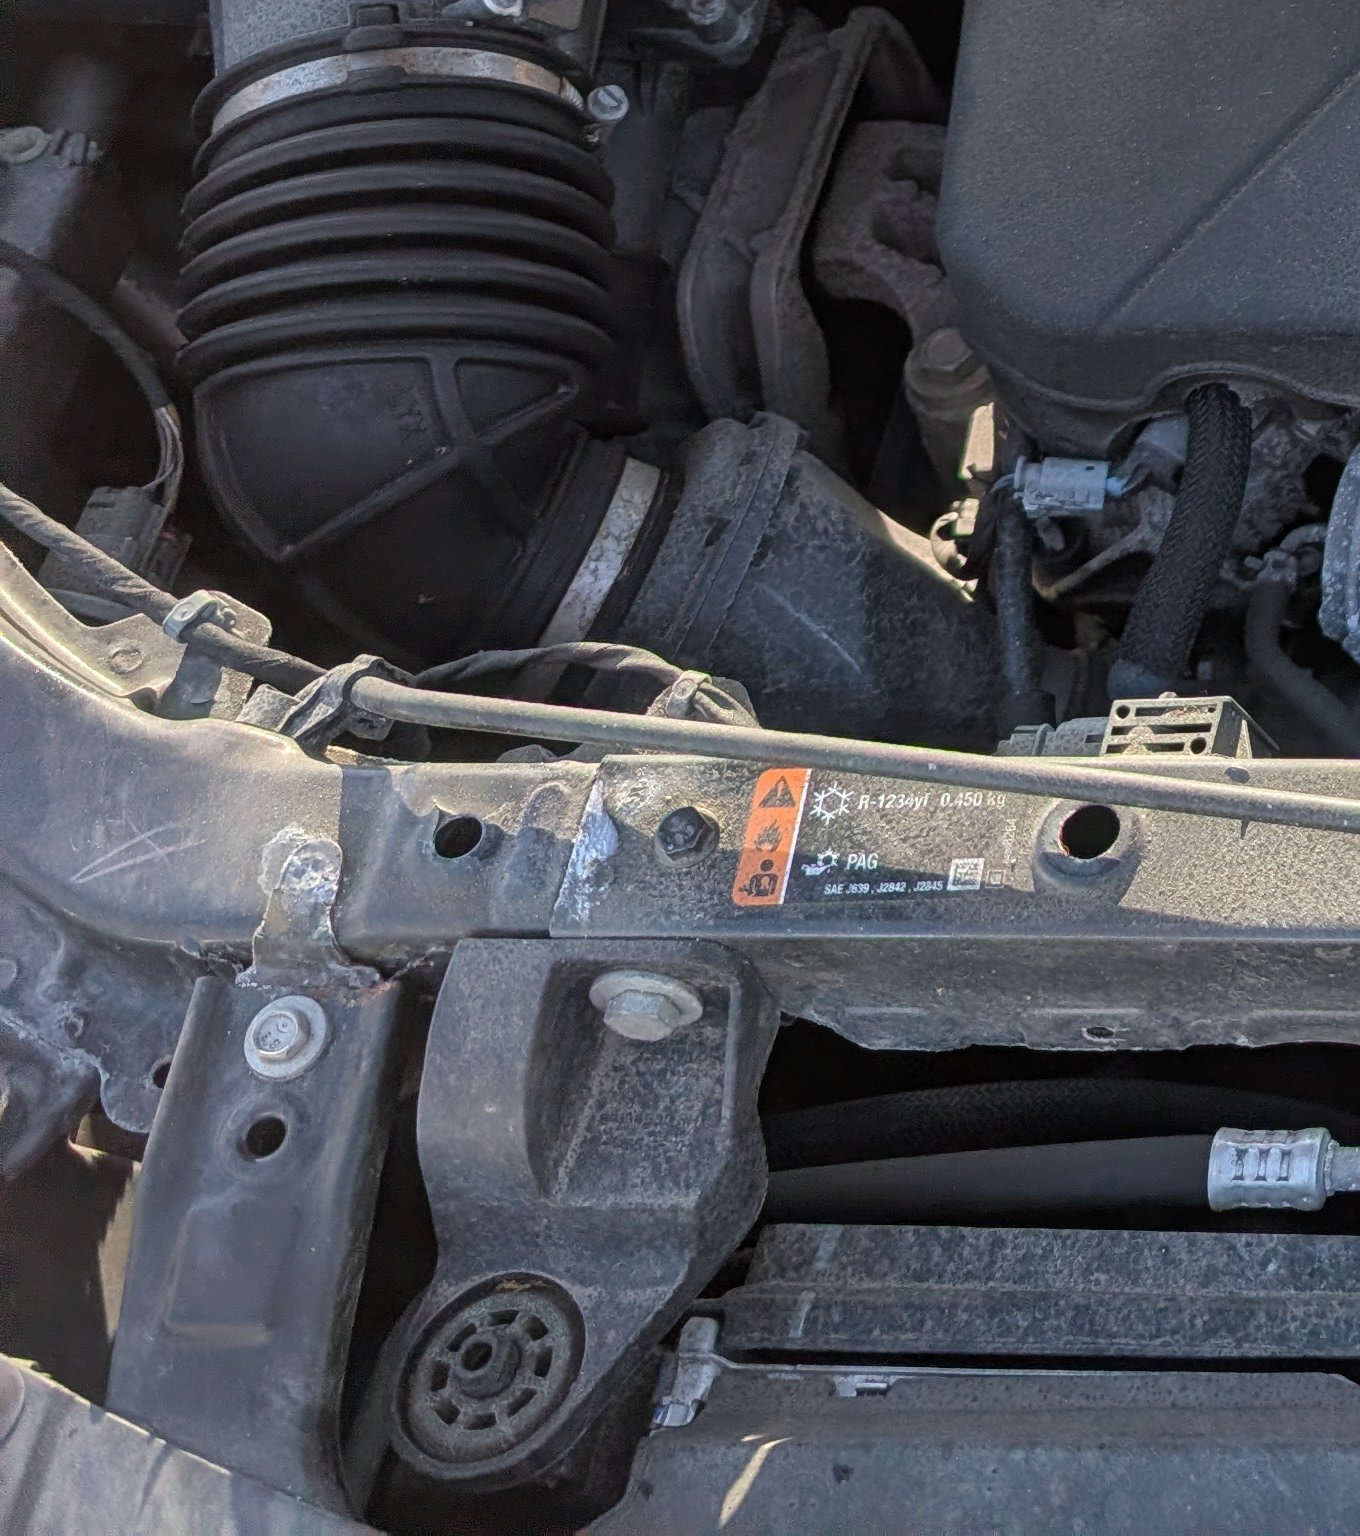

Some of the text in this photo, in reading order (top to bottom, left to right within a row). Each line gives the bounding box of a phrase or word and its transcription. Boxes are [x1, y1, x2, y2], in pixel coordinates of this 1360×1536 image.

[858, 792, 1006, 811] R-1234yf 0.450 kg
[846, 852, 879, 871] PAG
[824, 882, 844, 895] SAE
[876, 881, 907, 893] J2842
